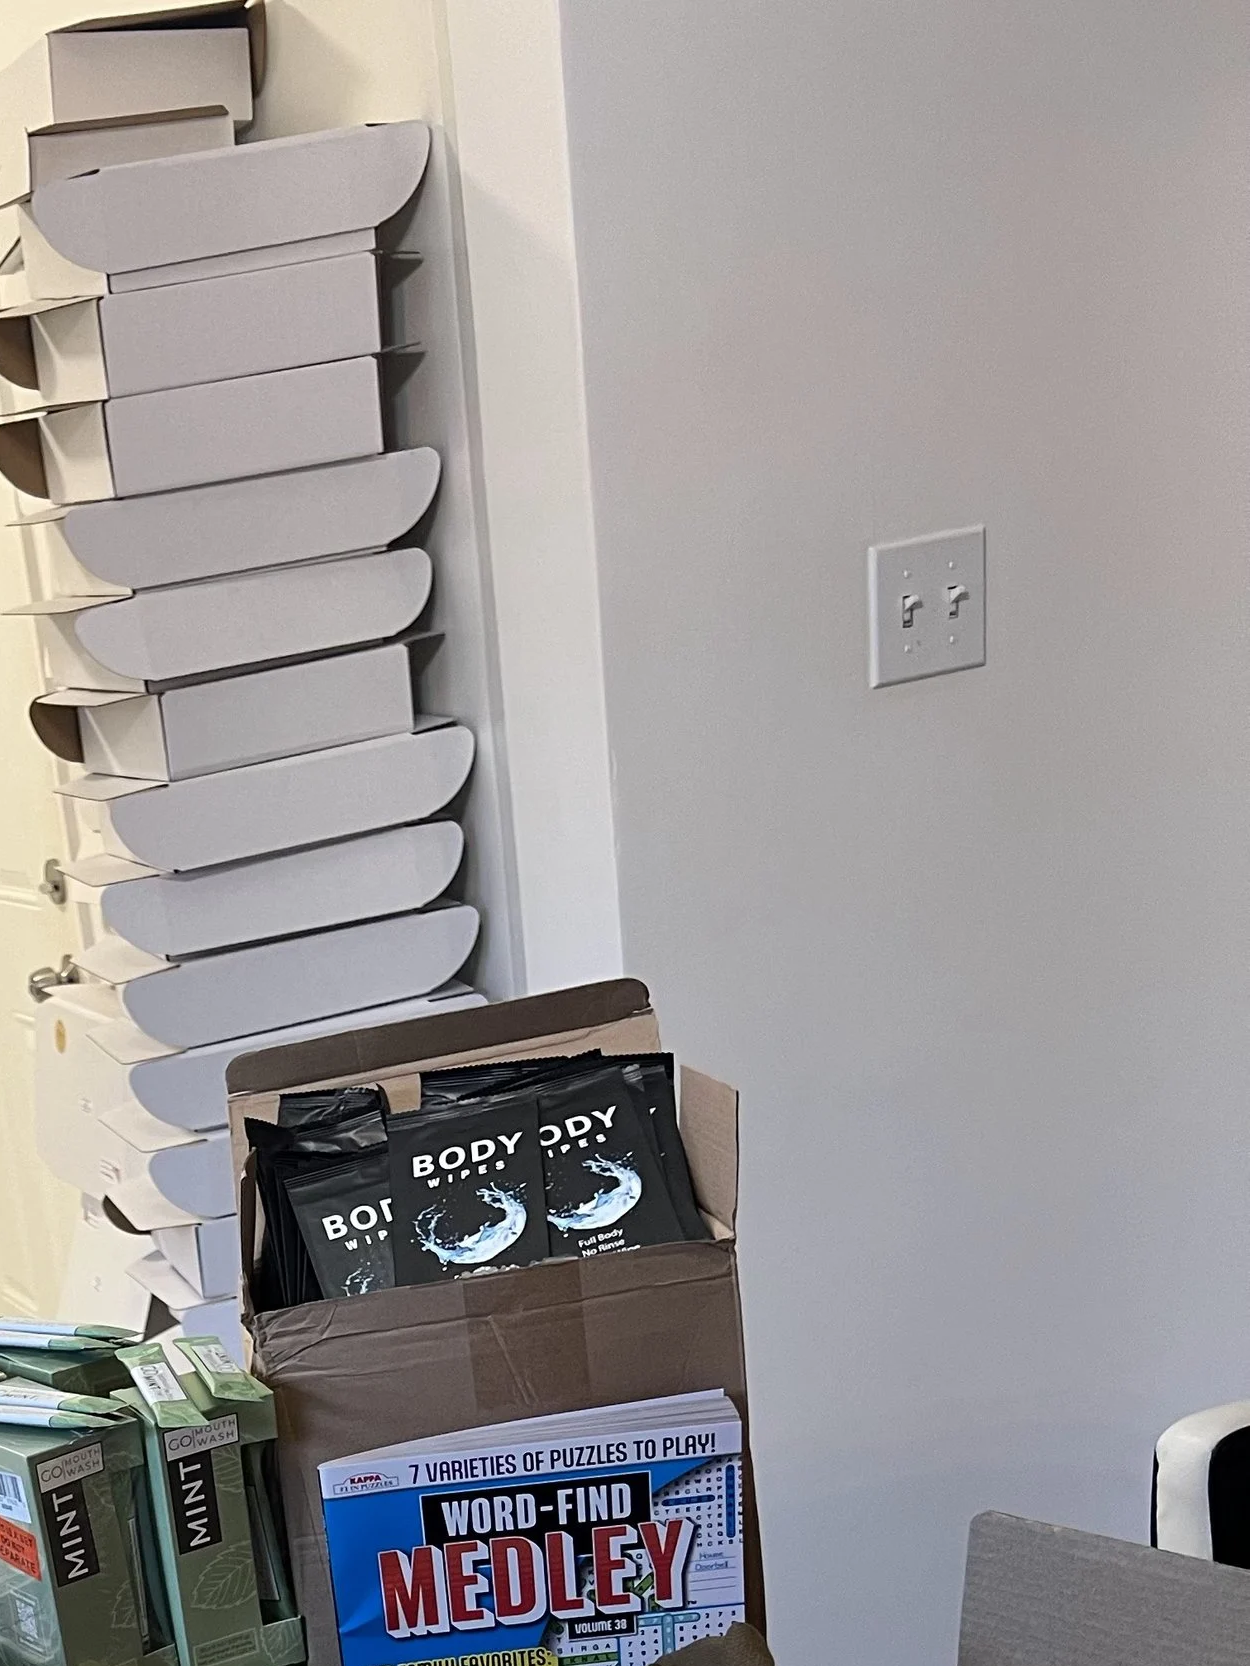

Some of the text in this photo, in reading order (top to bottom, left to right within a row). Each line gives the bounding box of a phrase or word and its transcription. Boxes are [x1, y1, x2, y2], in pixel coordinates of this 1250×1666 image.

[412, 1131, 524, 1178] BODY
[427, 1160, 506, 1189] WIPES
[597, 1226, 624, 1245] Body
[168, 1434, 192, 1451] GO
[197, 1430, 235, 1447] WASH
[41, 1447, 100, 1483] GO MOUTH
[67, 1458, 100, 1477] WASH
[408, 1432, 718, 1484] 7 VARIETIES OF PUZZLES TO PLAY!
[350, 1473, 382, 1485] KAPPA
[180, 1461, 211, 1548] MINT
[441, 1483, 632, 1537] WORD-FIND
[52, 1493, 89, 1579] MINT
[377, 1517, 696, 1638] MEDLEY
[574, 1620, 612, 1634] VOLUME
